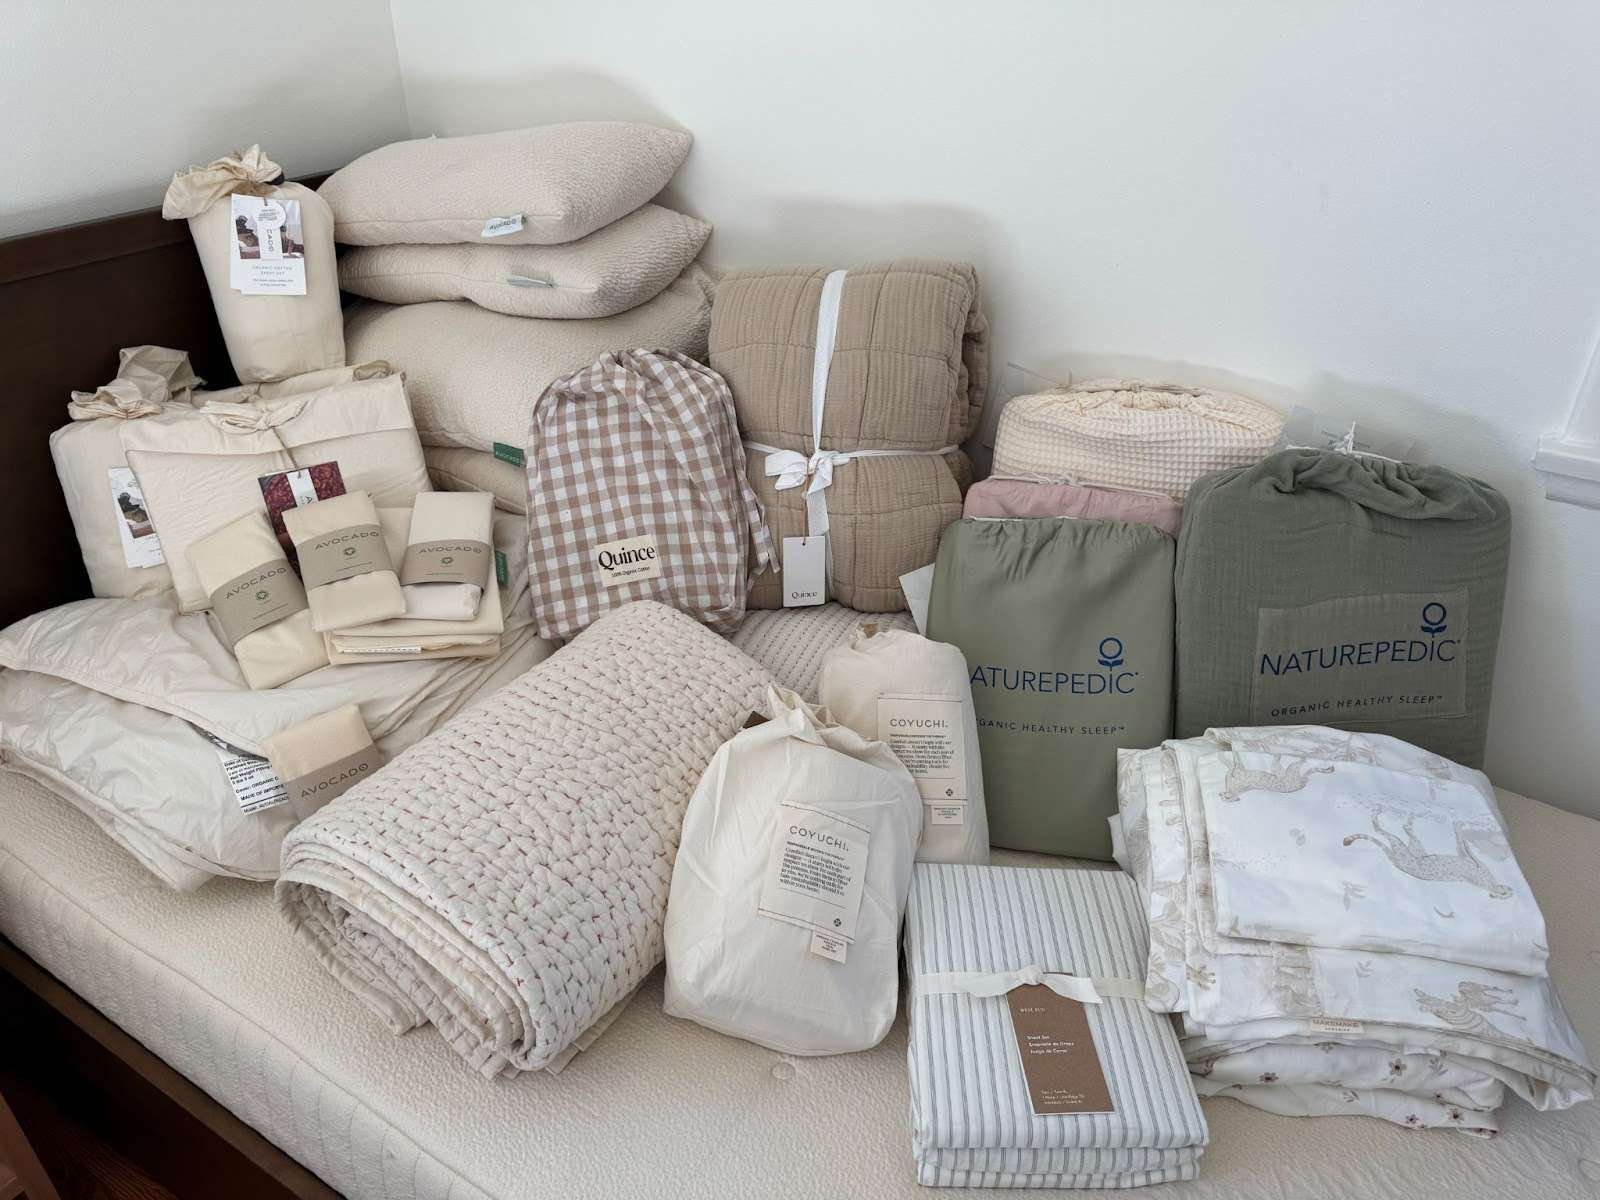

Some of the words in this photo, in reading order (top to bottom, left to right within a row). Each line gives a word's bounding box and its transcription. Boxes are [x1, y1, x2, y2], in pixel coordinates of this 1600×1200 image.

[314, 531, 379, 552] AVOCADO
[418, 545, 482, 554] AVOCADO
[598, 546, 655, 571] Quince
[225, 567, 287, 600] AVOCADO
[791, 591, 817, 600] Quince
[1260, 639, 1457, 676] NATUREPEDIC
[970, 665, 1135, 695] ATUREPEDIC
[1271, 700, 1330, 717] ORGANIC
[1337, 695, 1395, 709] HEALTHY
[977, 718, 1017, 730] GANIC
[1022, 724, 1075, 734] HEALTHY
[251, 778, 275, 788] ORGANIC
[301, 763, 369, 799] AVOCADO
[240, 793, 255, 801] MADE
